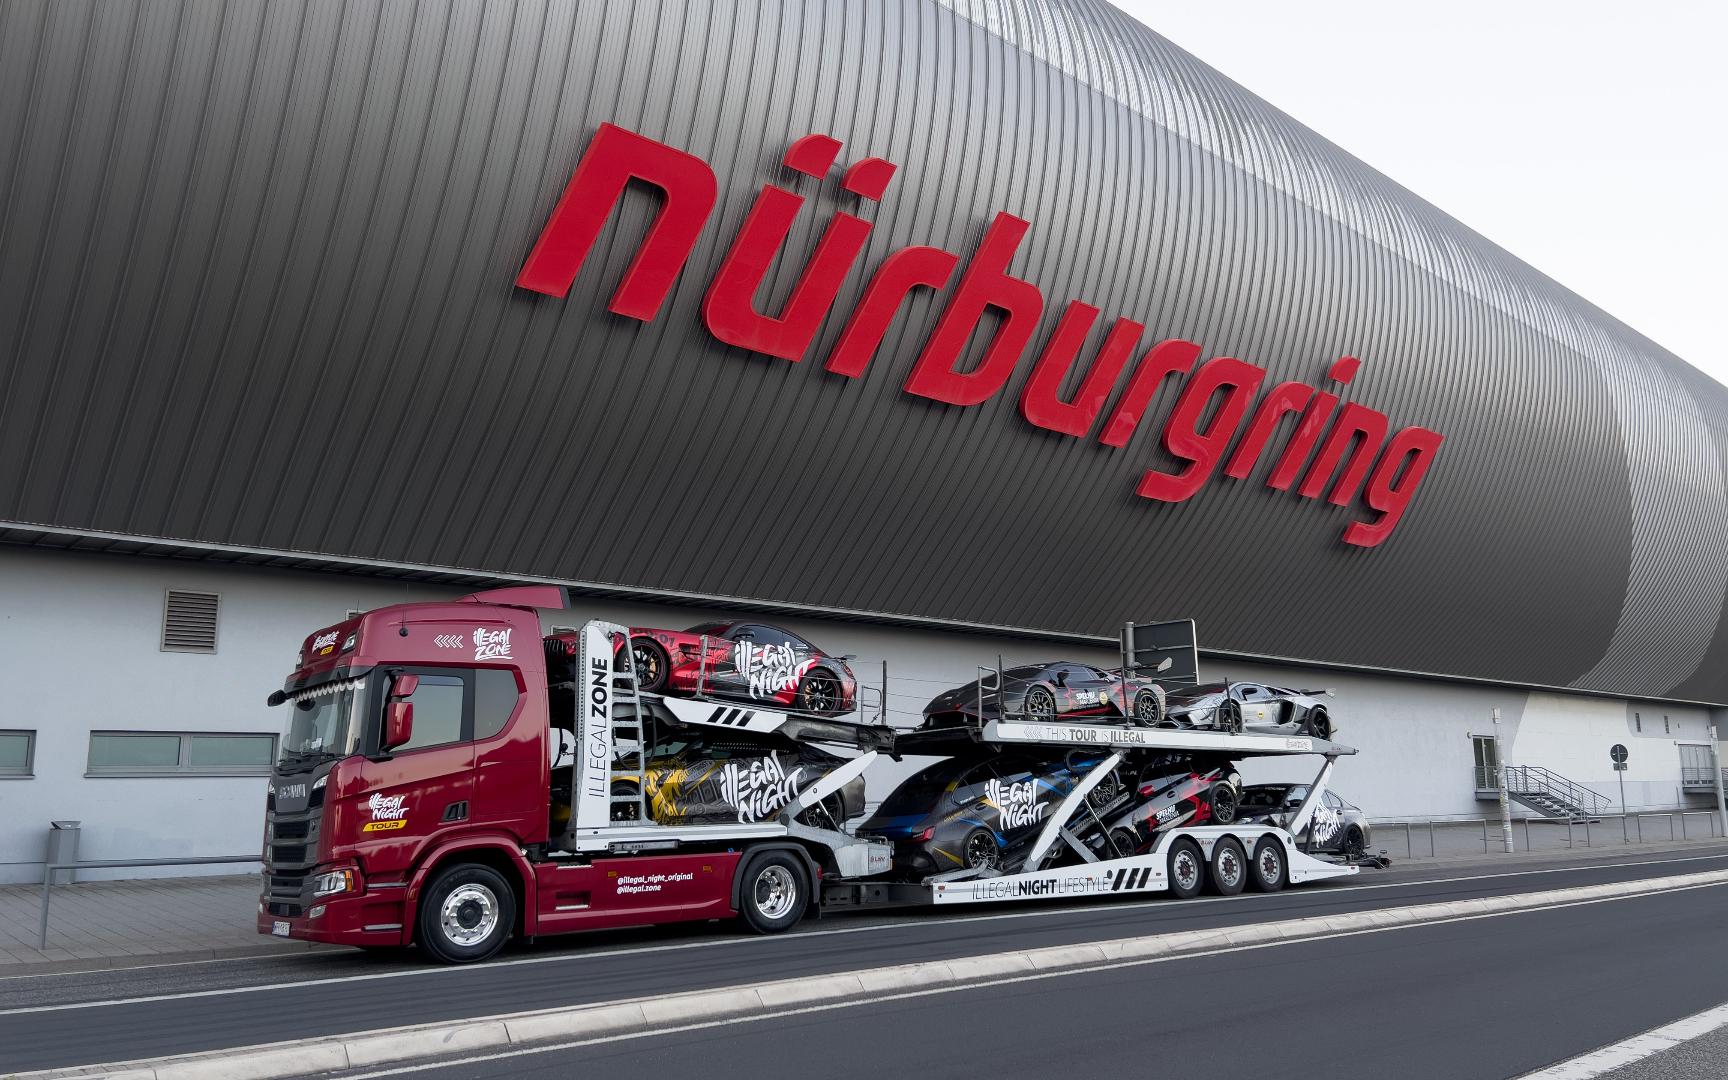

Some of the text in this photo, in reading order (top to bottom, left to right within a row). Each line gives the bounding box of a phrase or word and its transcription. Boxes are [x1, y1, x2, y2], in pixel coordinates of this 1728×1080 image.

[515, 121, 1444, 548] nürburgring
[1069, 729, 1097, 742] TOUR
[1110, 731, 1146, 744] ILLEGAL
[370, 822, 400, 830] TOUR
[617, 872, 694, 886] @illegal_night_original
